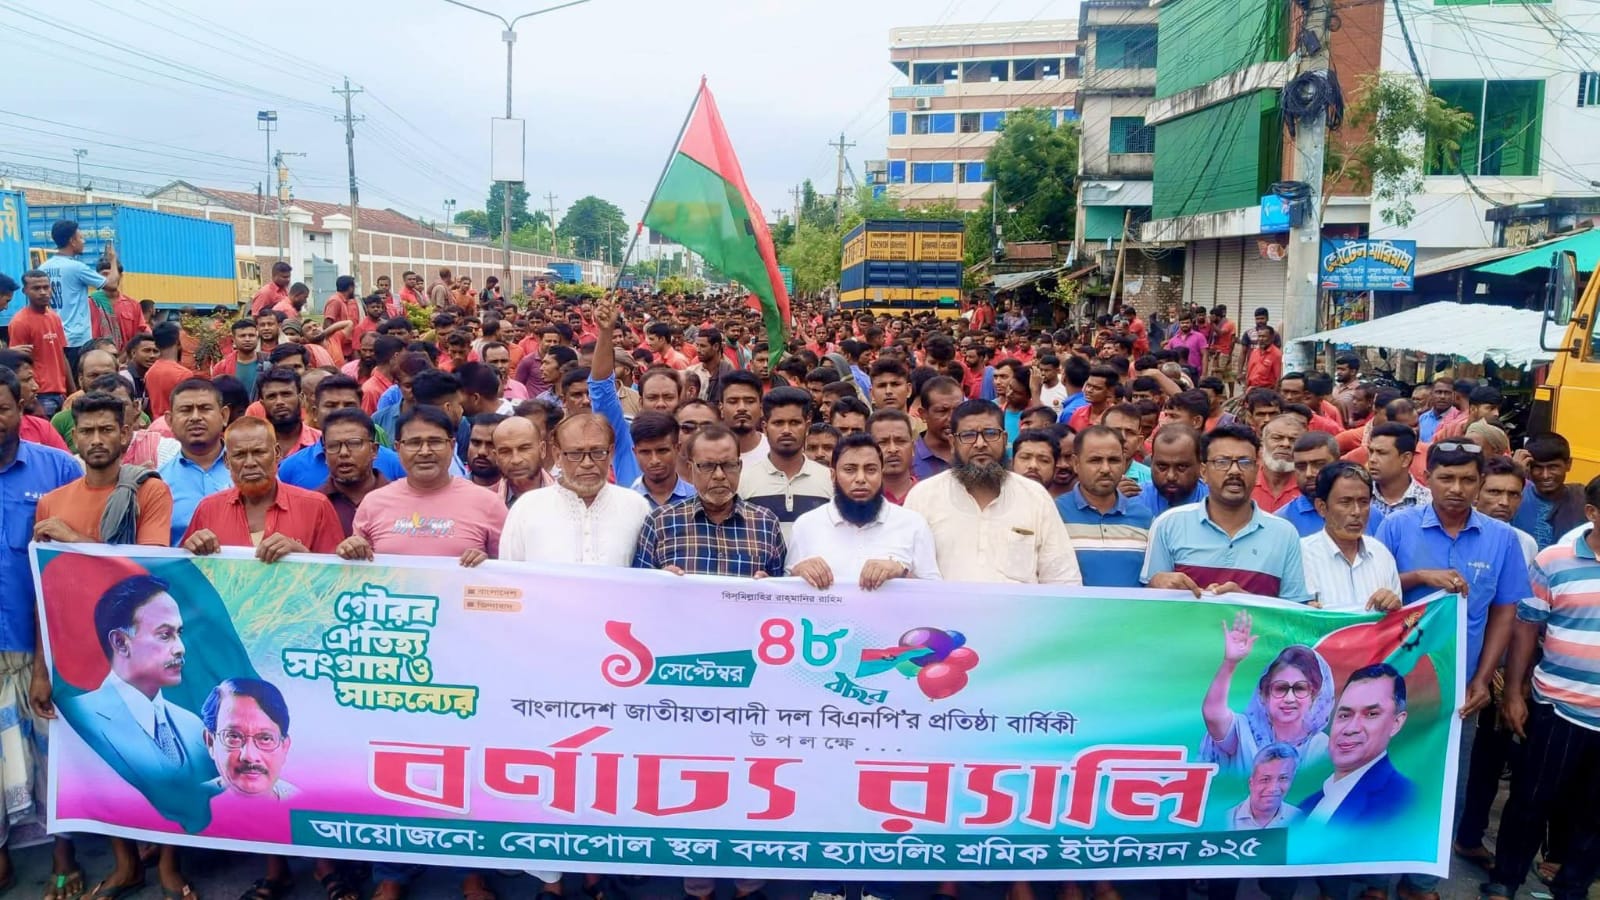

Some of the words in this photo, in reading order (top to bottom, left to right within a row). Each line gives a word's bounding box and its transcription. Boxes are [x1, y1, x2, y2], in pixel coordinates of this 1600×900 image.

[336, 584, 438, 626] গৌরব
[324, 622, 428, 657] ঐতিহ্য
[601, 620, 653, 687] ১
[658, 658, 746, 683] সেপ্টেম্বর
[758, 618, 848, 666] ৪৮
[283, 649, 401, 680] সংগ্রাম
[409, 658, 432, 682] ও
[334, 681, 478, 717] সাফল্যের
[511, 698, 616, 720] বাংলাদেশ
[624, 699, 769, 725] জাতীয়তাবাদী
[776, 709, 812, 727] দল
[928, 708, 998, 732] প্রতিষ্ঠা
[1006, 711, 1077, 734] বার্ষিকী
[369, 726, 803, 820] বর্ণাঢ্য
[309, 819, 485, 850] আয়োজনে:
[500, 832, 654, 859] বেনাপোল
[664, 837, 721, 862] স্থল
[730, 840, 810, 863] বন্দর
[820, 836, 946, 865] হ্যান্ডলিং
[956, 836, 1050, 865] শ্রমিক
[1058, 836, 1190, 865] ইউনিয়ন
[1198, 838, 1263, 861] ৯২৫
